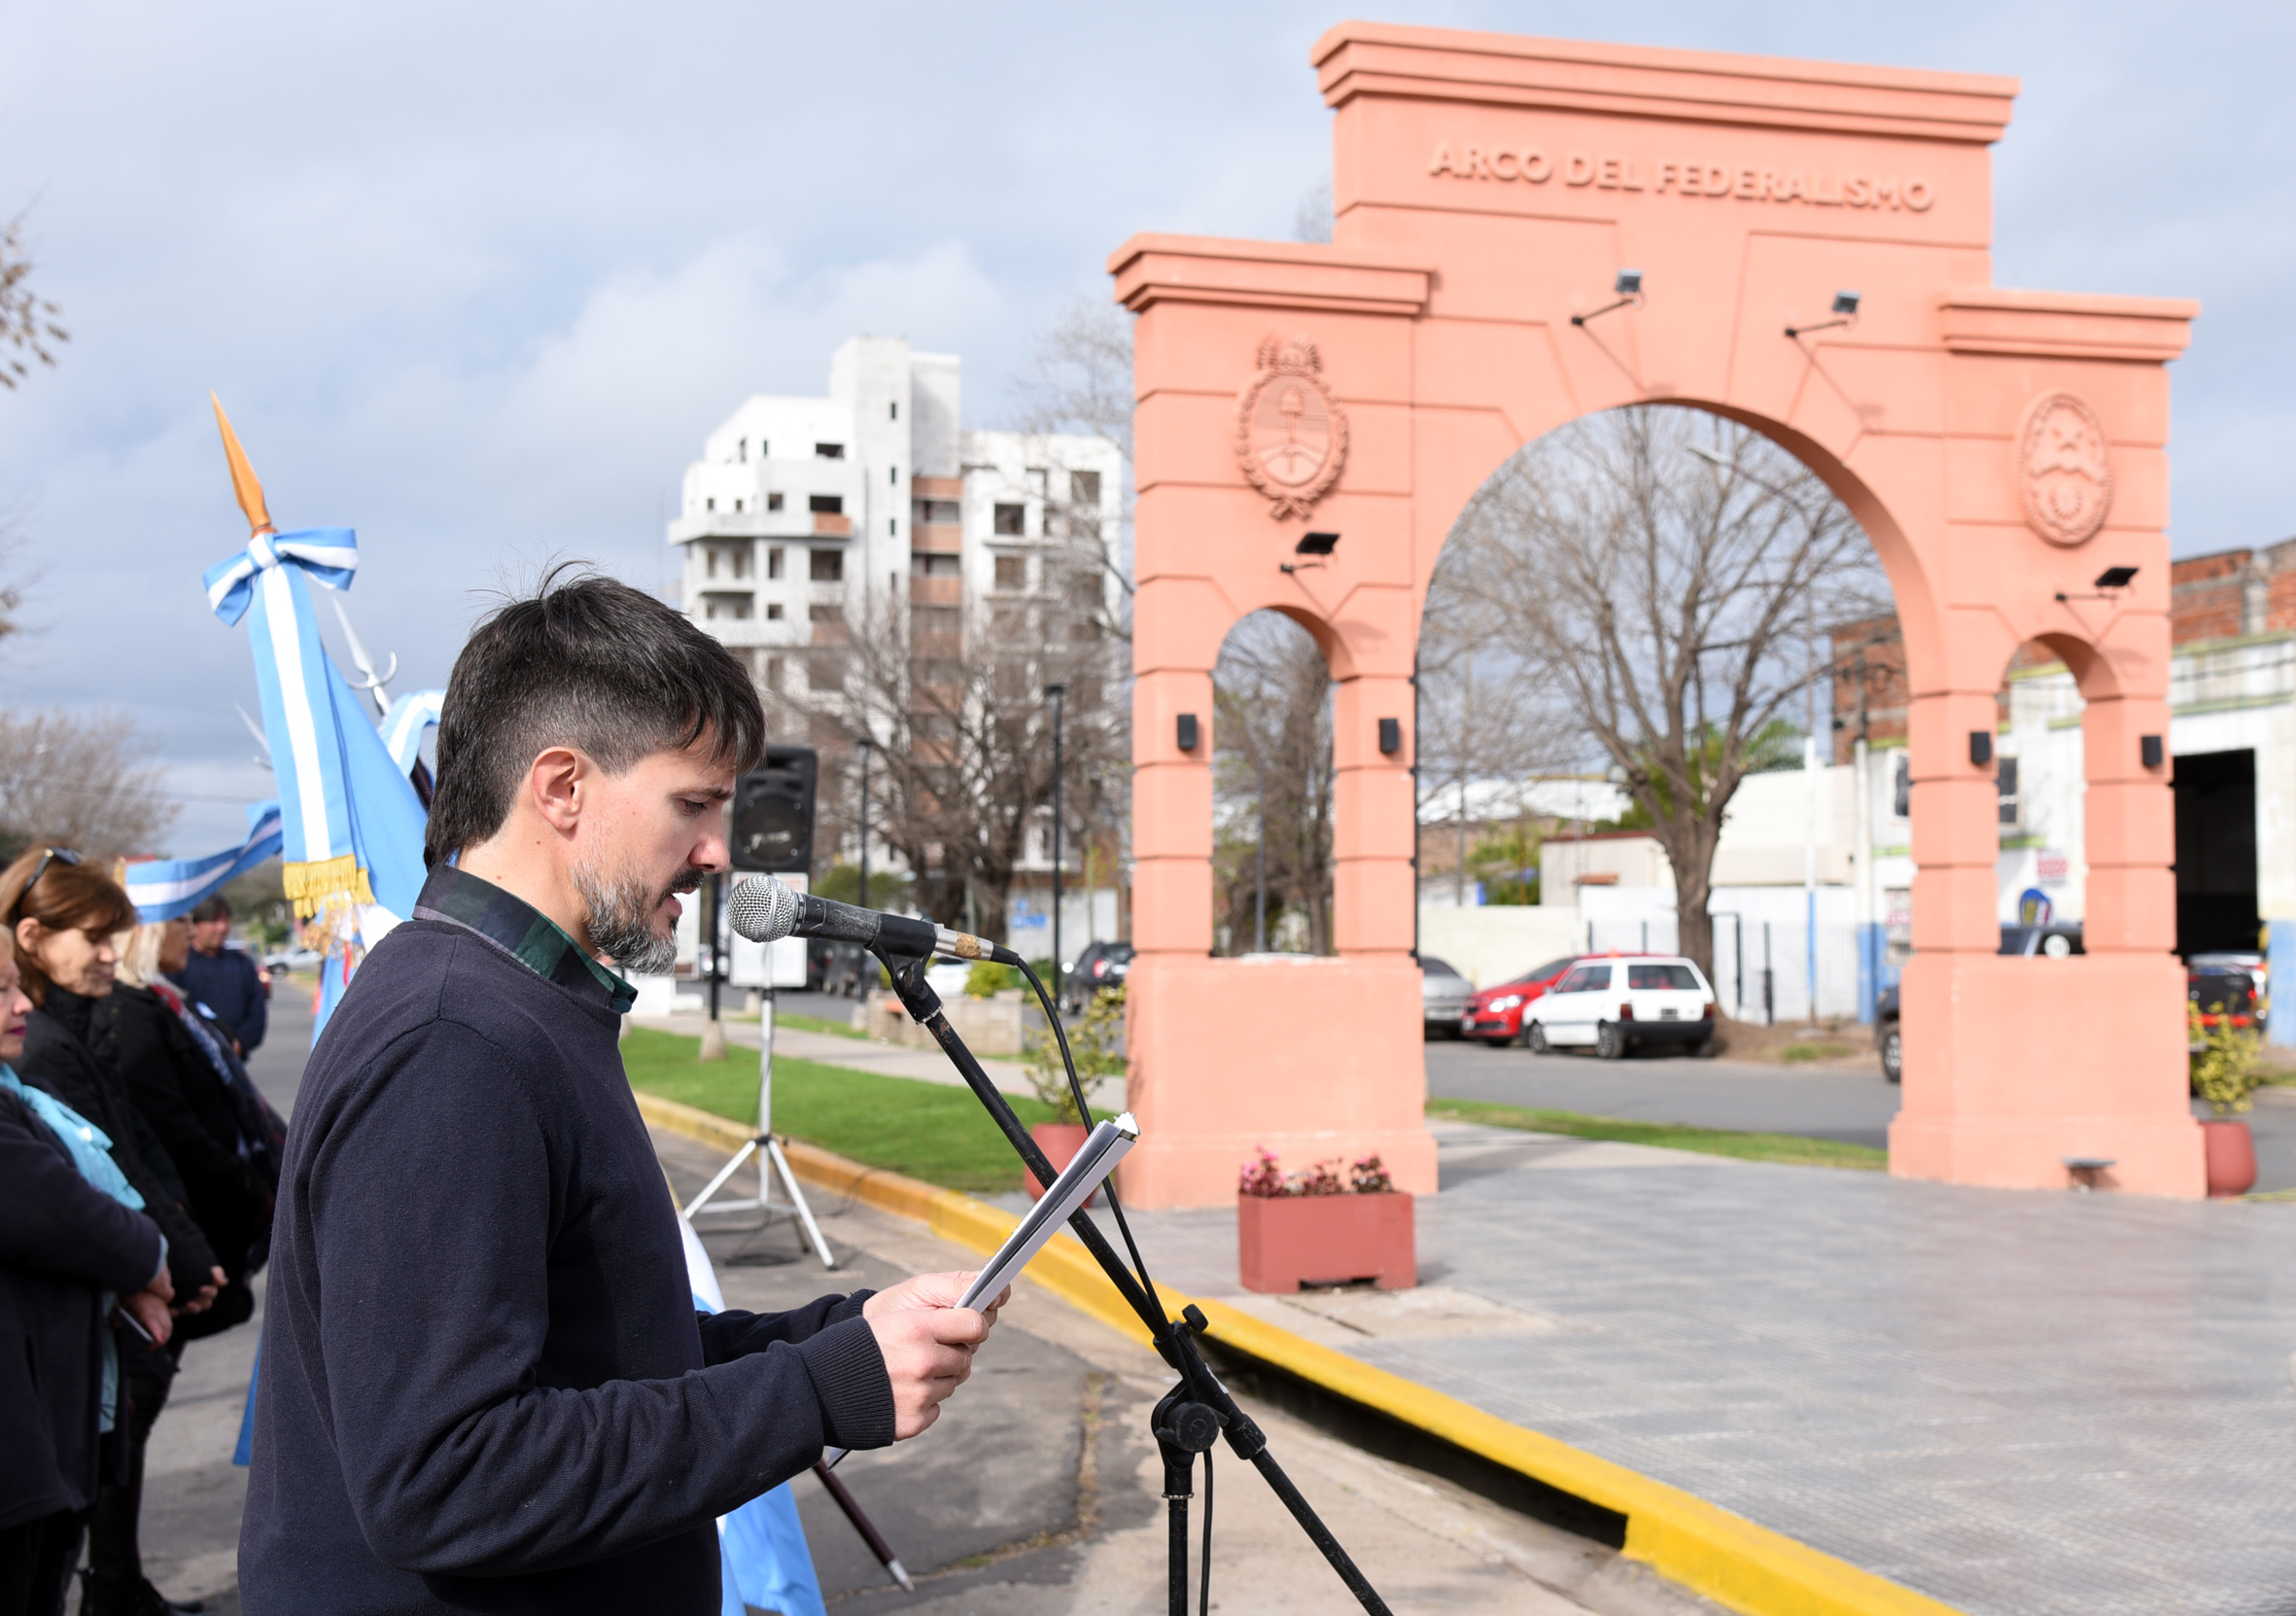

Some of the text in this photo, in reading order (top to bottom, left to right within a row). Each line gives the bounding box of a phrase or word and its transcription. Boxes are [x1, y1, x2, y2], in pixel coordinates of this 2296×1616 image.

[1429, 143, 1935, 212] ARCO DEL FEDERALISMO
